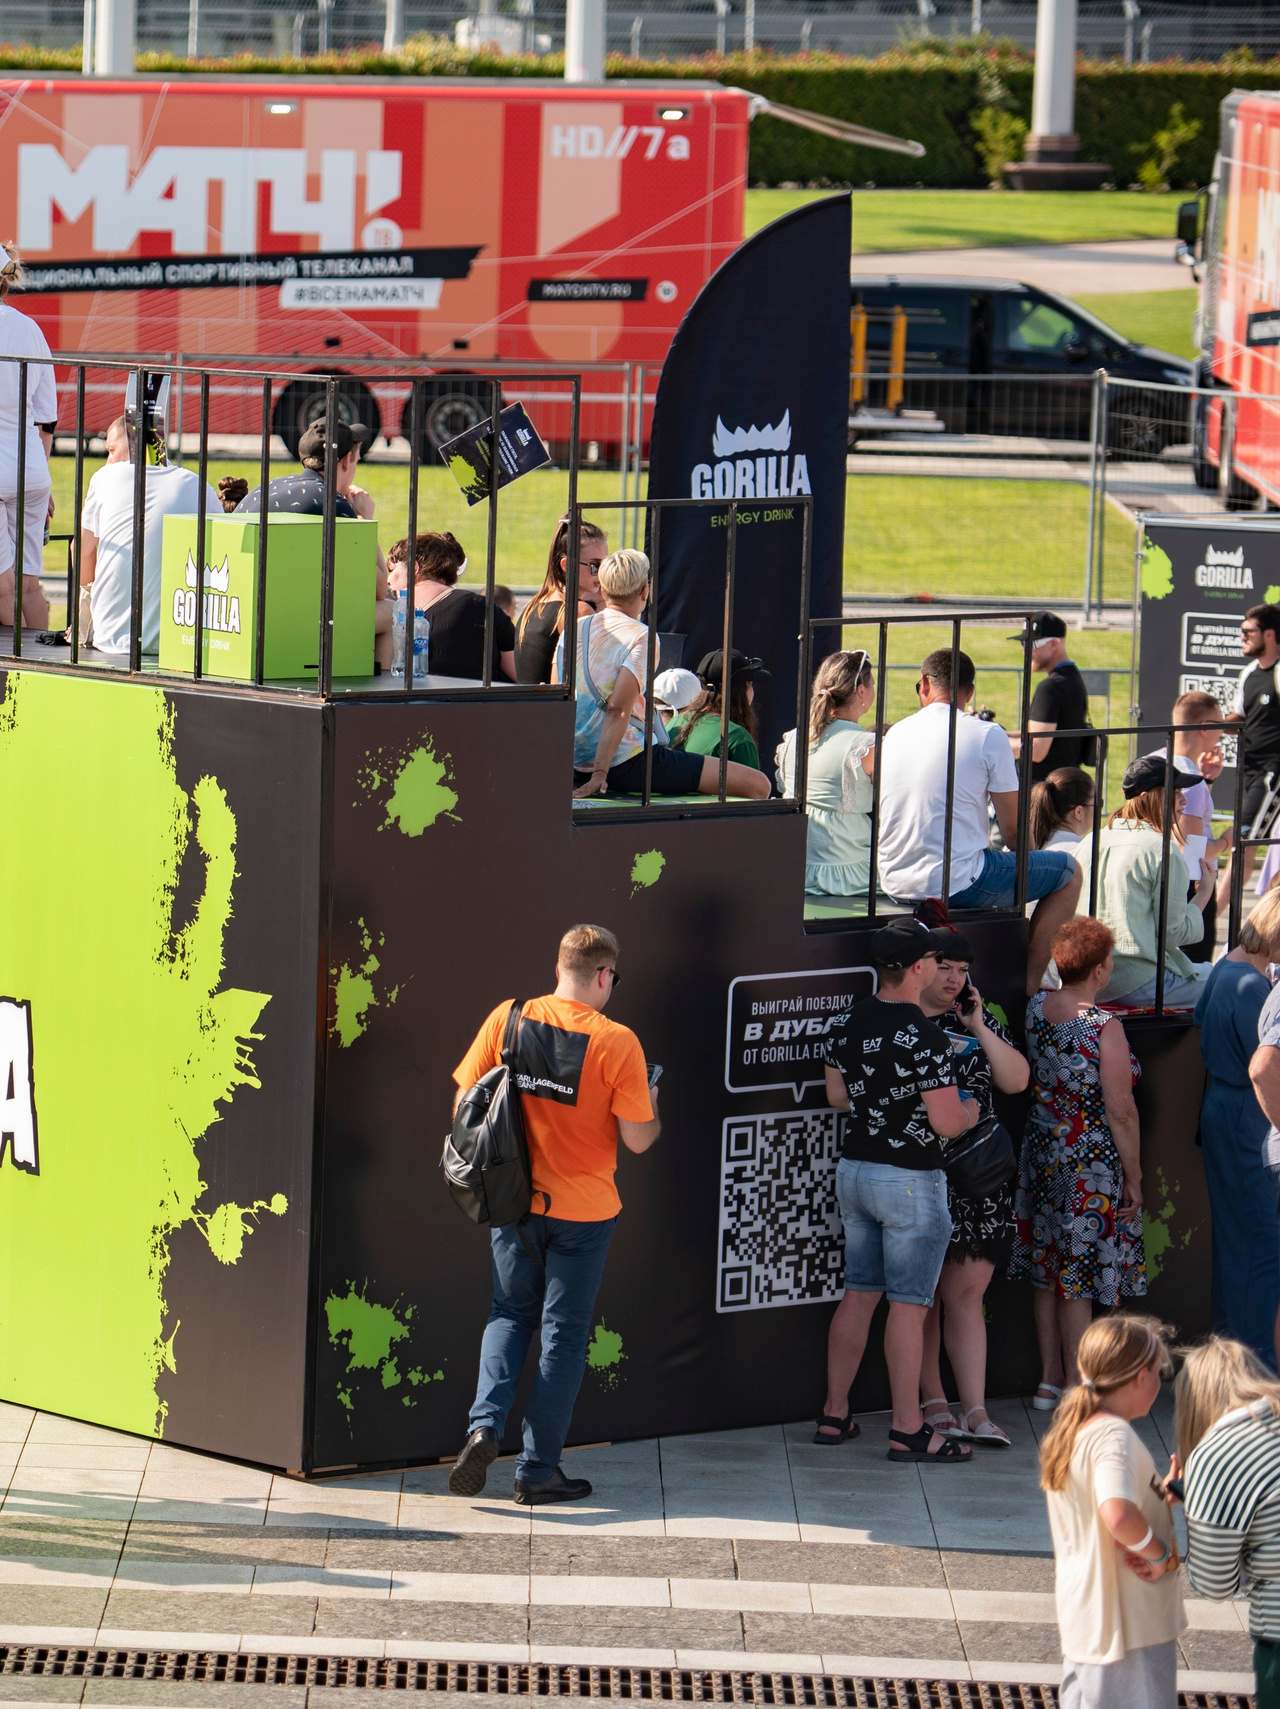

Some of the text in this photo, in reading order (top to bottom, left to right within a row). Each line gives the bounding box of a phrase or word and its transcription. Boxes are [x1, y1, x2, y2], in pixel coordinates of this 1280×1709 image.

[23, 255, 414, 290] ЦИОНАЛЬНЫЙ СПОРТИВНЫЙ ТЕЛЕКАНАЛ
[293, 284, 424, 303] #ВСЕНАМАТЧ
[691, 454, 812, 500] GORILLA
[711, 508, 794, 527] ENRGY DRINK
[1196, 565, 1254, 590] GORILLA
[210, 638, 231, 651] DRINK
[1191, 634, 1204, 644] В
[751, 994, 854, 1017] ВЫИГРАЙ ПОЕЗДКУ
[744, 1023, 763, 1042] В
[894, 1030, 919, 1047] EA7
[863, 1037, 883, 1051] EA7
[743, 1048, 758, 1065] ОТ
[761, 1044, 810, 1063] GORILLA
[913, 1049, 931, 1061] EA7
[937, 1062, 951, 1076] EA7
[517, 1081, 536, 1091] EANS
[533, 1077, 573, 1094] LAGERFELD
[848, 1080, 865, 1095] EA7
[890, 1083, 916, 1098] EA7
[906, 1121, 935, 1143] EA7
